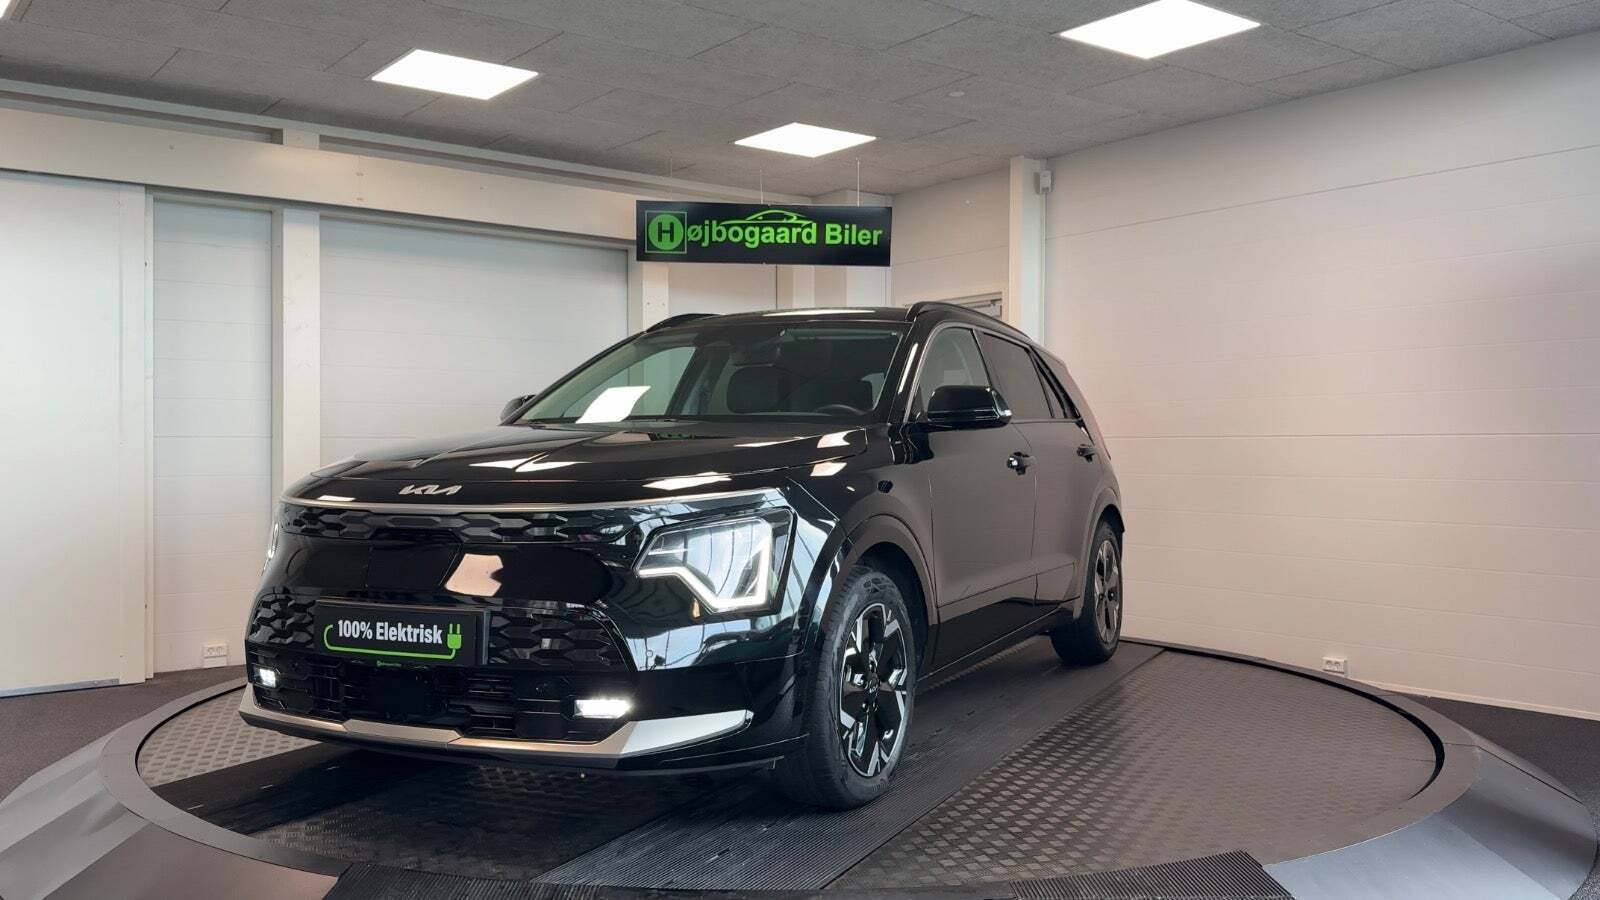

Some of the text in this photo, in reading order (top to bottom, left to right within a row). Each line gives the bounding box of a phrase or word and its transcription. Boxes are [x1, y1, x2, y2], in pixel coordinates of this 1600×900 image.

[825, 223, 883, 246] Biler
[398, 484, 463, 496] KIA
[338, 619, 443, 645] 100% Elektrisk
